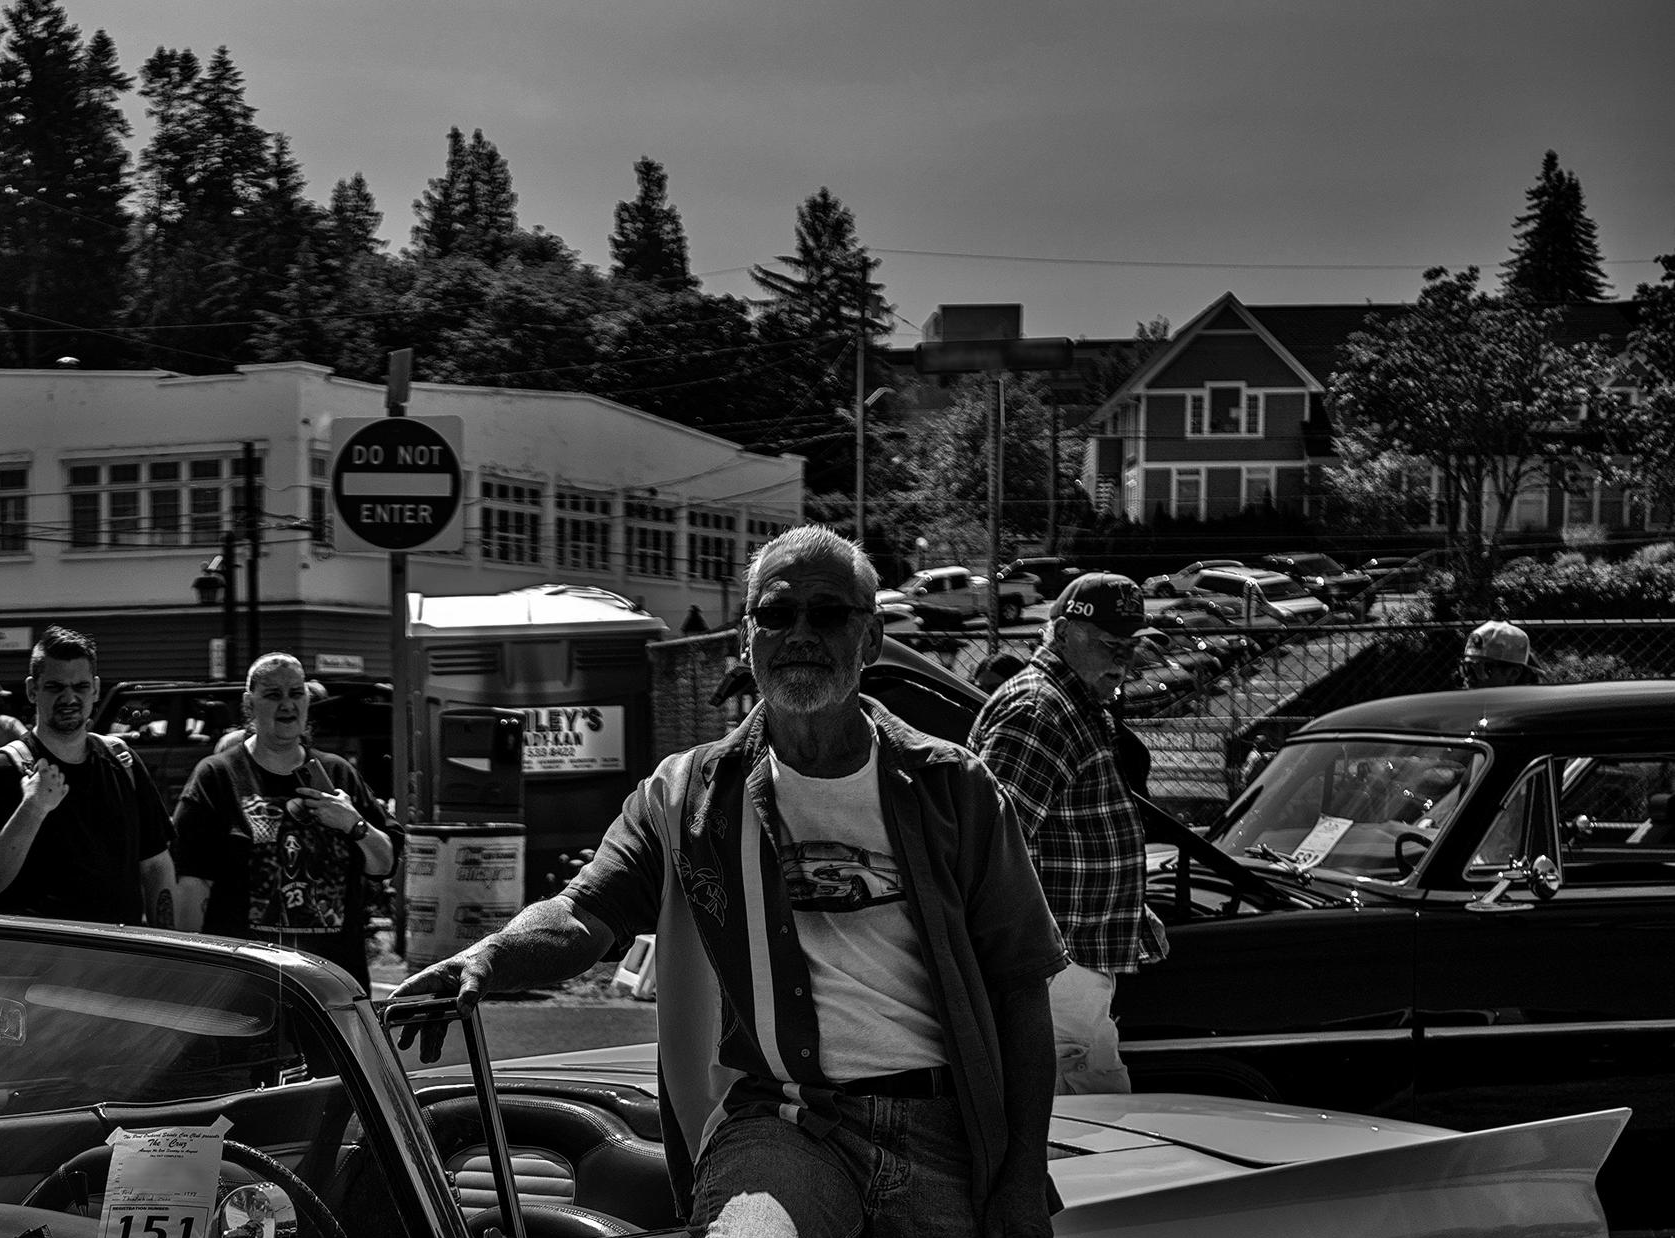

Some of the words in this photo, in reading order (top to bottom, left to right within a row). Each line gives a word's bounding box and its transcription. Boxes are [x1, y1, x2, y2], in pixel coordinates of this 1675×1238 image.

[351, 444, 385, 465] DO
[396, 444, 444, 465] NOT
[359, 503, 434, 524] ENTER
[1066, 599, 1094, 617] 250
[285, 889, 305, 909] 23
[147, 1138, 162, 1147] The
